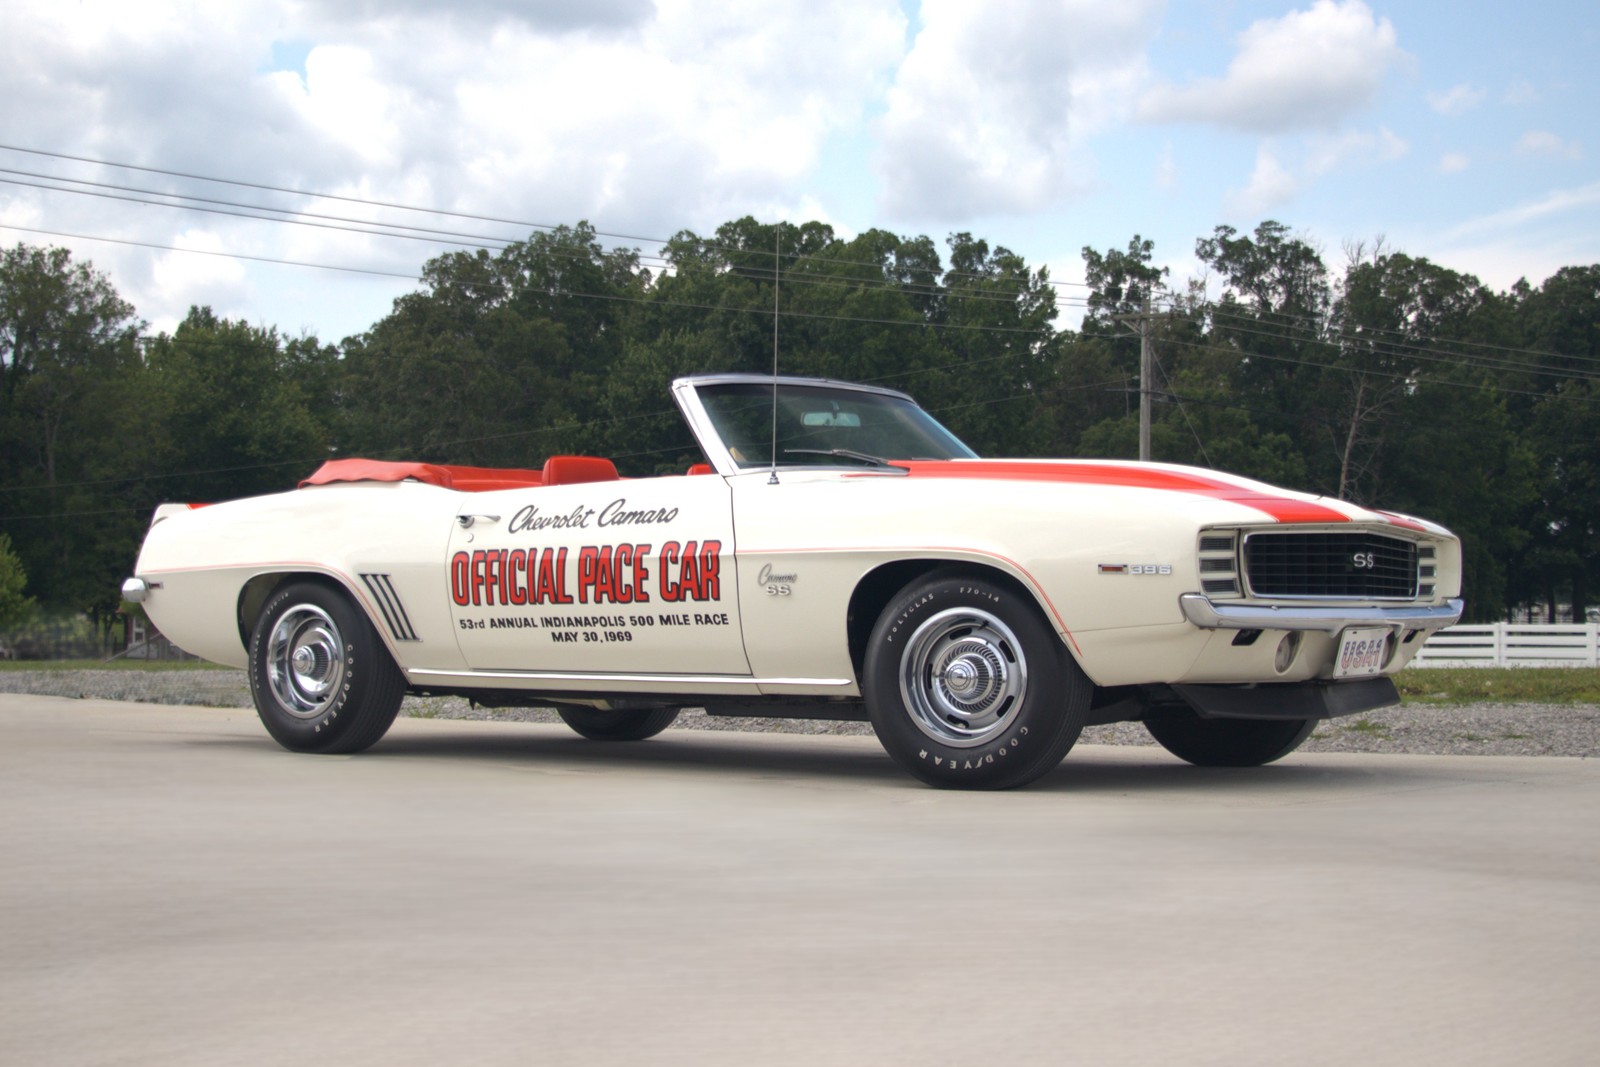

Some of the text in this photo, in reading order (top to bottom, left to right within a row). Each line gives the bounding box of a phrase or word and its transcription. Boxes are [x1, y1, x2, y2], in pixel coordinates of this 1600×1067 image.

[508, 498, 679, 534] Chevrolet Camaro
[451, 539, 722, 606] OFFICIAL PACE CAR
[1353, 553, 1374, 569] SS
[766, 584, 792, 597] SS
[459, 613, 730, 629] 53rd ANNUAL INDIANAPOLIS 500 MILE RACE
[887, 586, 1000, 642] POLYGLAS F70-14
[550, 632, 579, 643] MAY
[918, 725, 1030, 769] GOODYEAR
